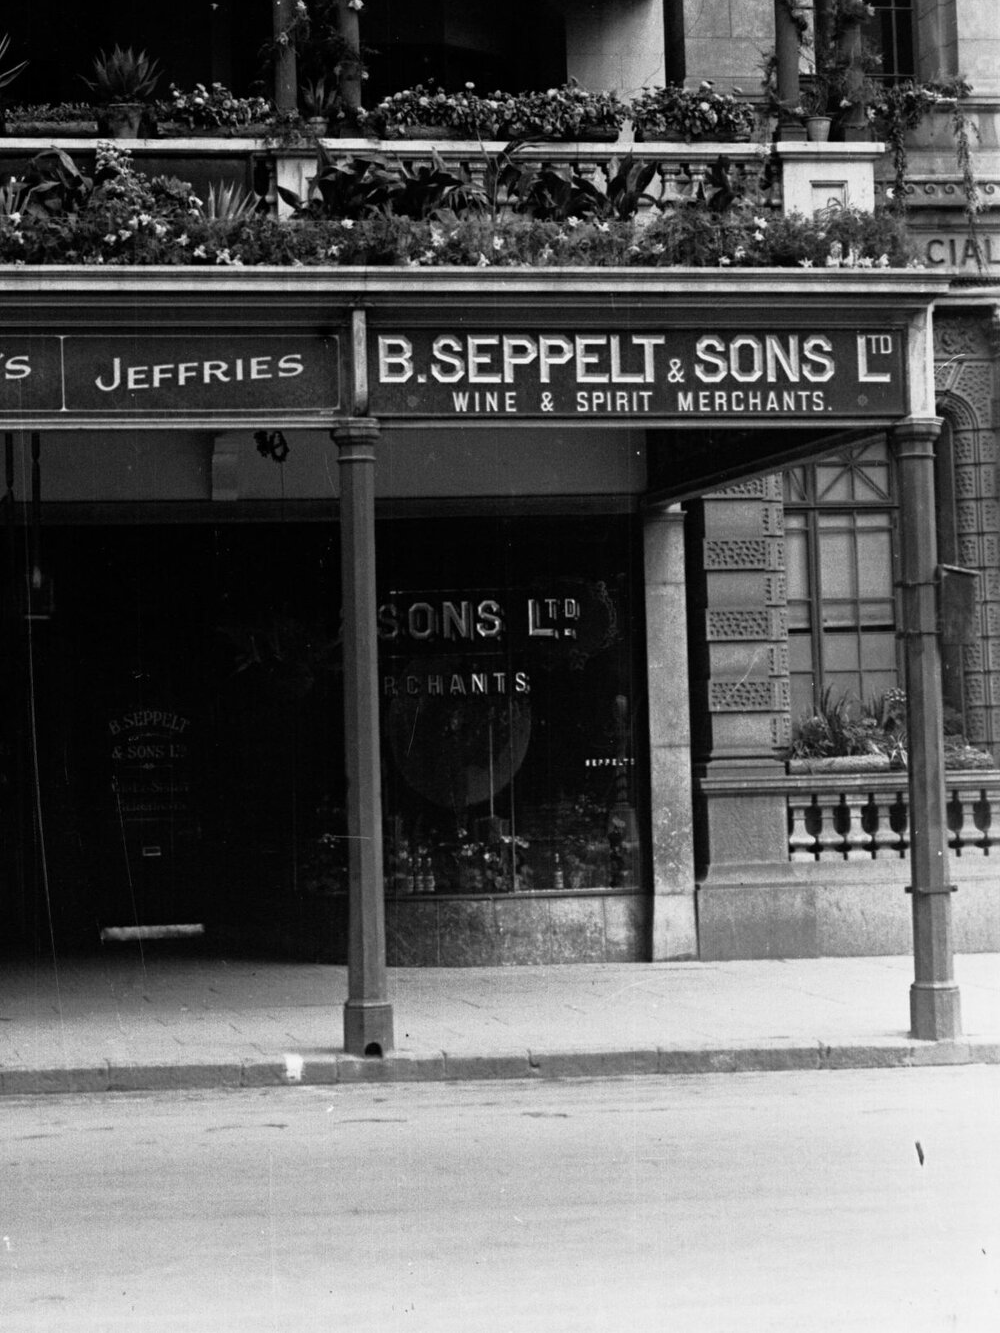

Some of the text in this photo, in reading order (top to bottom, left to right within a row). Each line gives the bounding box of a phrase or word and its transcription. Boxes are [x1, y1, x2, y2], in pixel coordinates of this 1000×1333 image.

[94, 353, 304, 392] JEFFRIES
[667, 357, 685, 383] &
[694, 334, 835, 383] SONS
[856, 333, 893, 383] LTD
[453, 391, 517, 412] WINE
[541, 391, 554, 412] &
[576, 390, 653, 412] SPIRIT
[377, 599, 504, 641] SONS
[384, 671, 531, 696] RCHANTS
[128, 745, 165, 759] SONS
